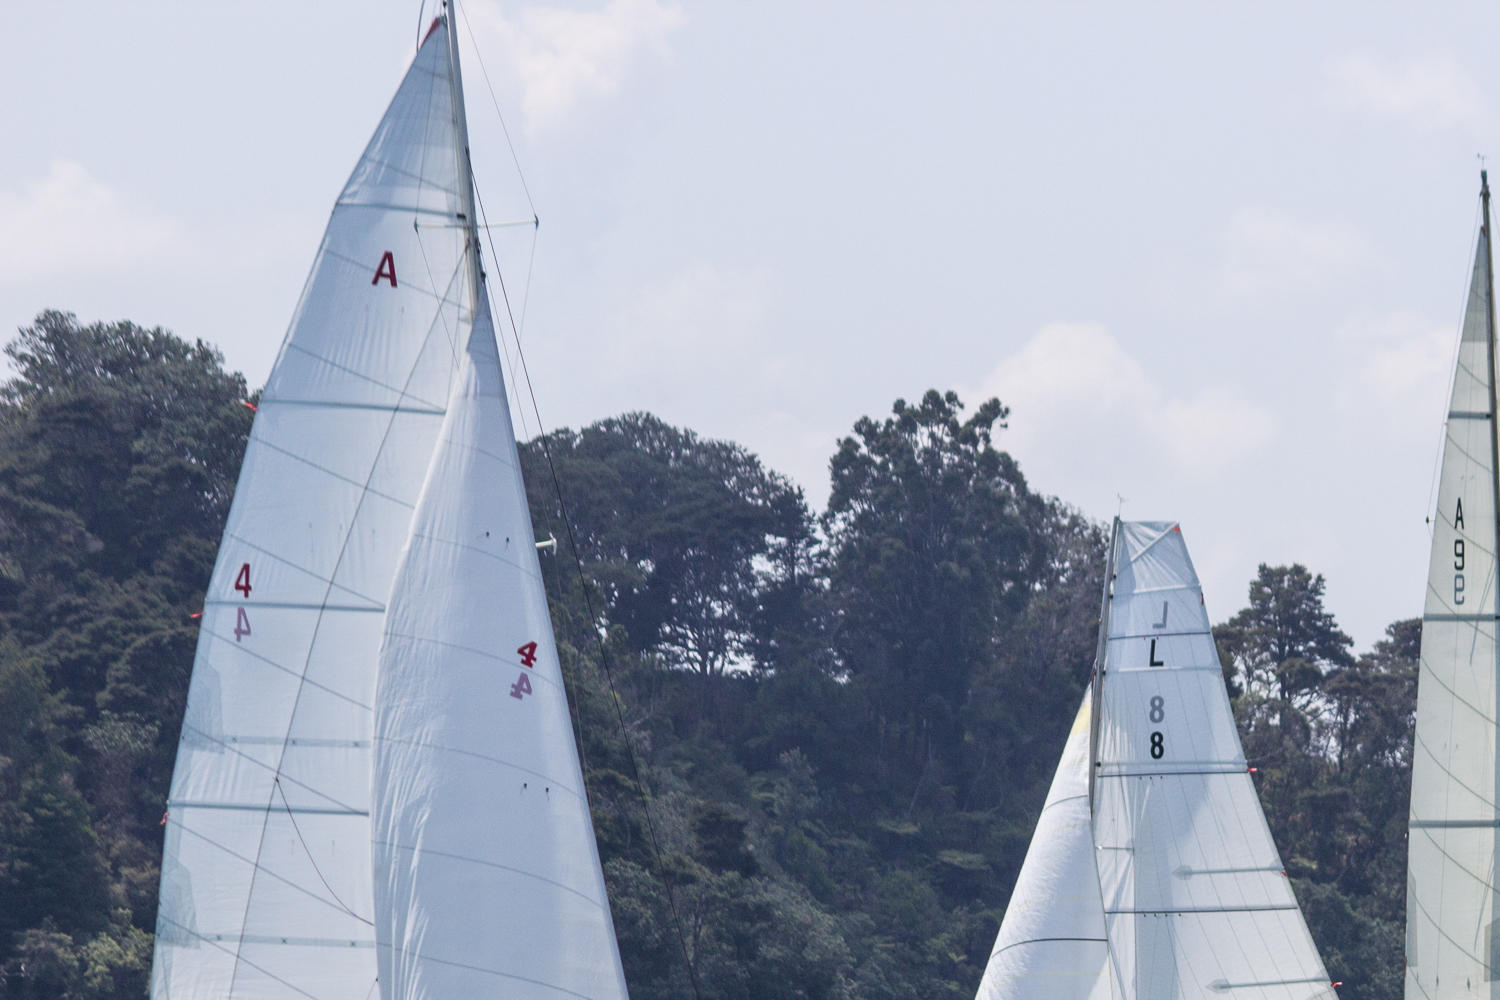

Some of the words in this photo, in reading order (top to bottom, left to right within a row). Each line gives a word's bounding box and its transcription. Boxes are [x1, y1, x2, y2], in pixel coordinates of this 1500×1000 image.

[372, 250, 399, 288] A
[1454, 497, 1464, 530] A
[1454, 539, 1464, 571] 9
[234, 563, 252, 599] 4
[517, 640, 538, 668] 4
[1149, 639, 1164, 667] L
[1150, 731, 1164, 759] 8
